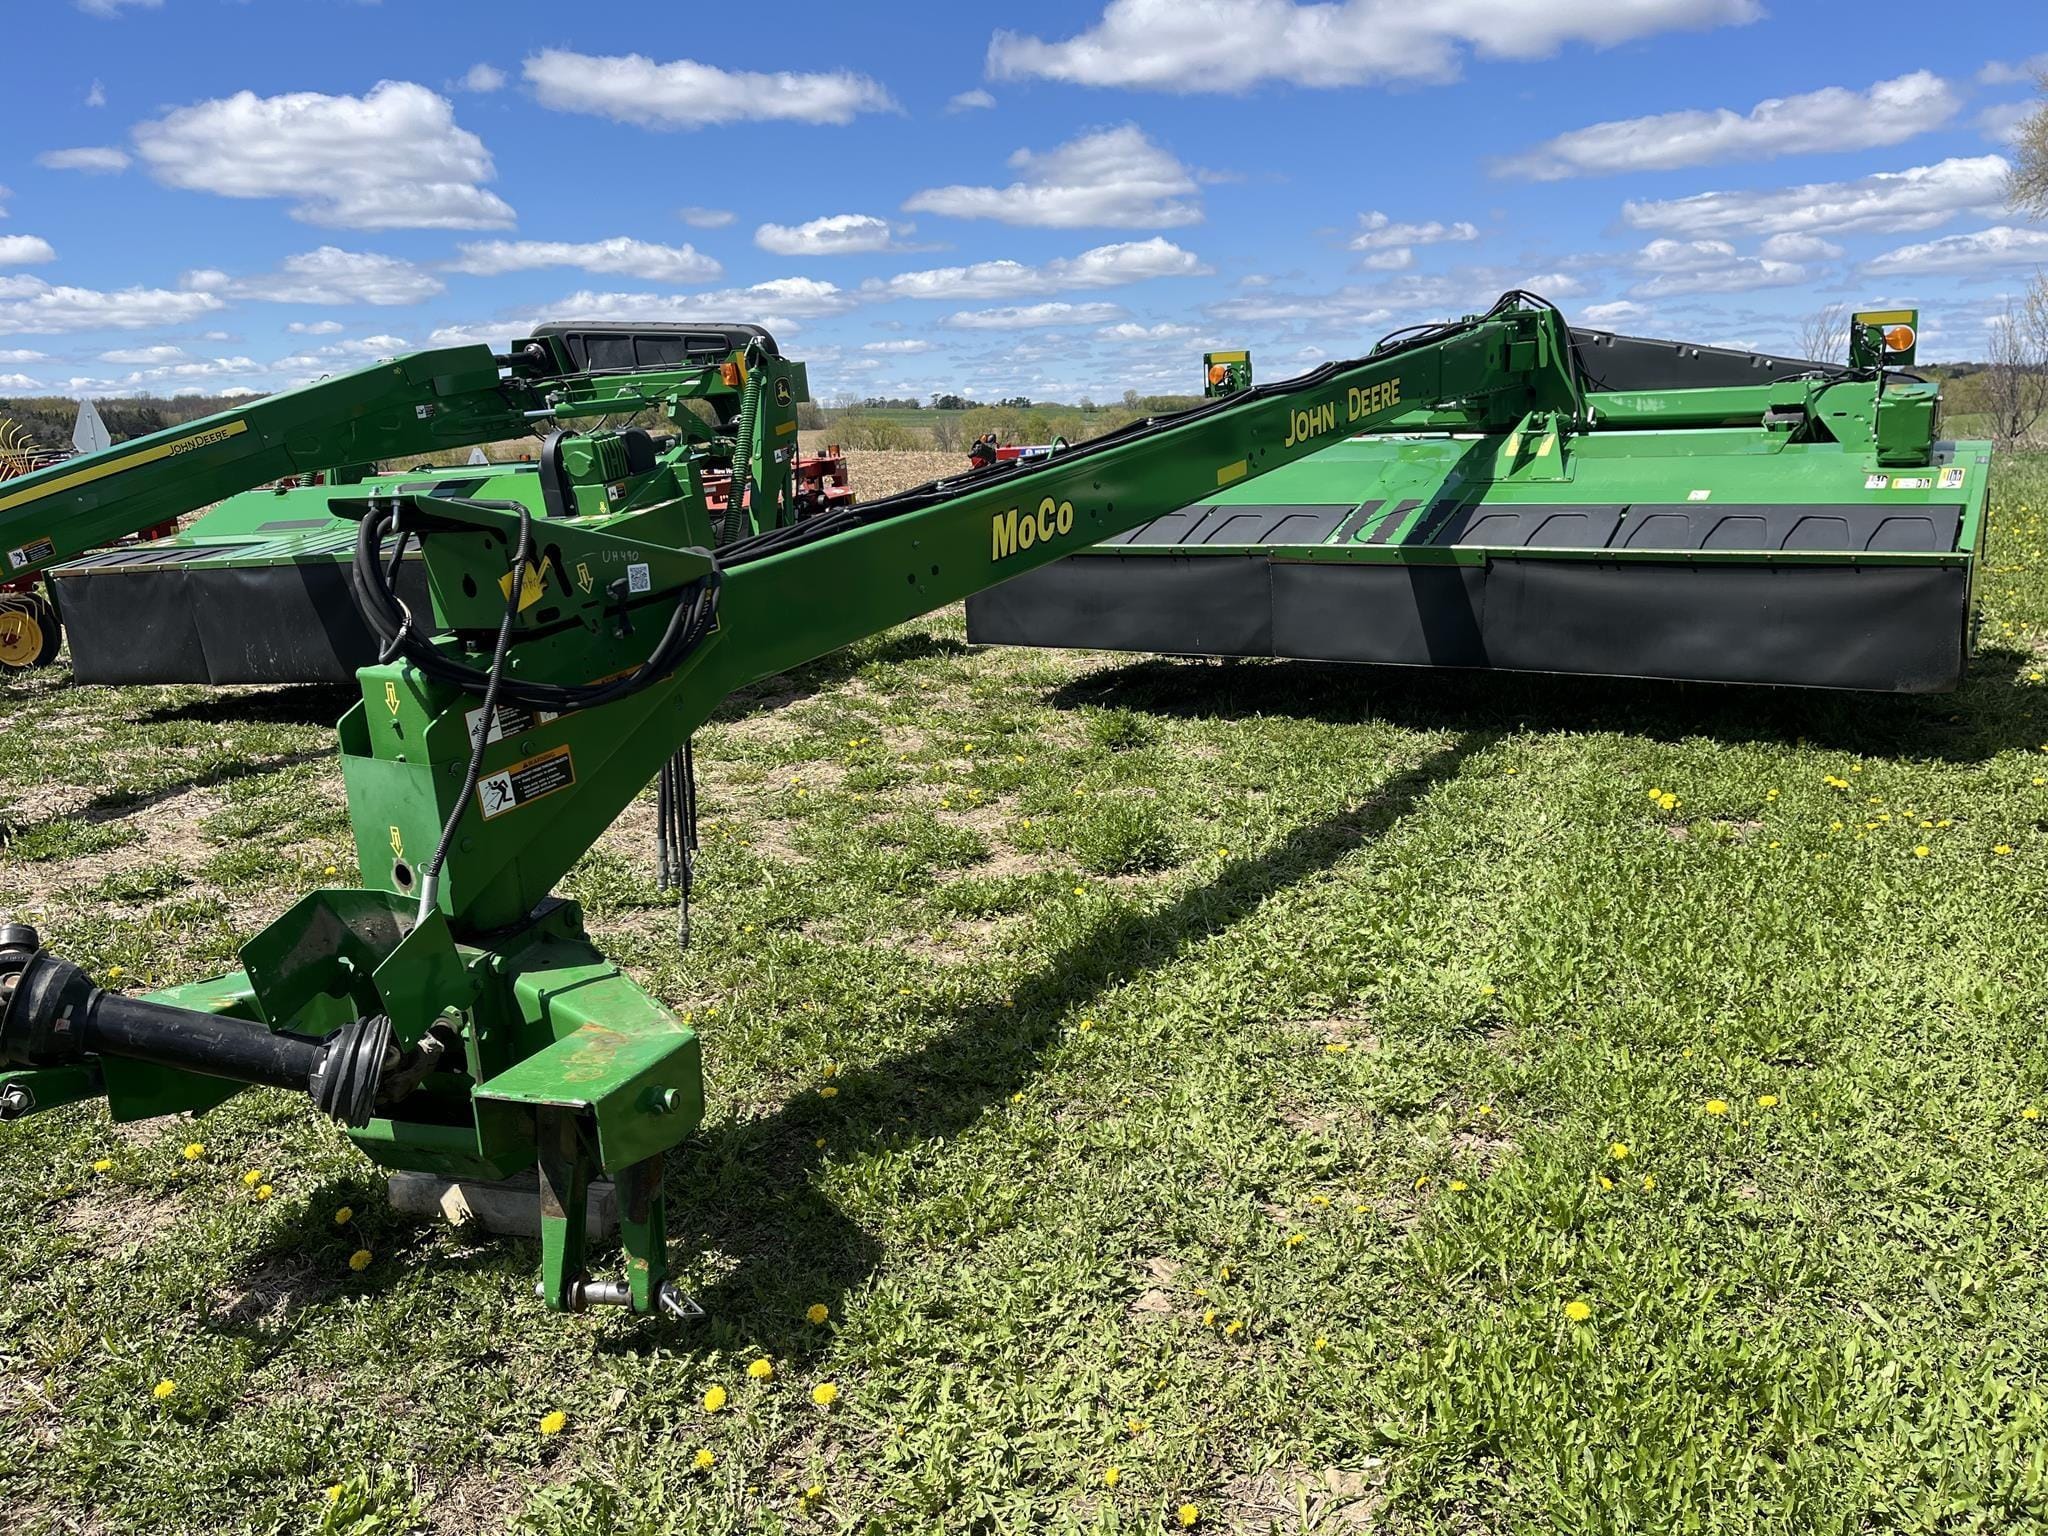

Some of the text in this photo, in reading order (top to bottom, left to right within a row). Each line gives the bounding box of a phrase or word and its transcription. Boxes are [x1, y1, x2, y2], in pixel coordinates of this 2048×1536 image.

[169, 429, 230, 456] JOHN DEERE
[1285, 377, 1401, 448] JOHN DEERE
[992, 496, 1074, 562] MoCo
